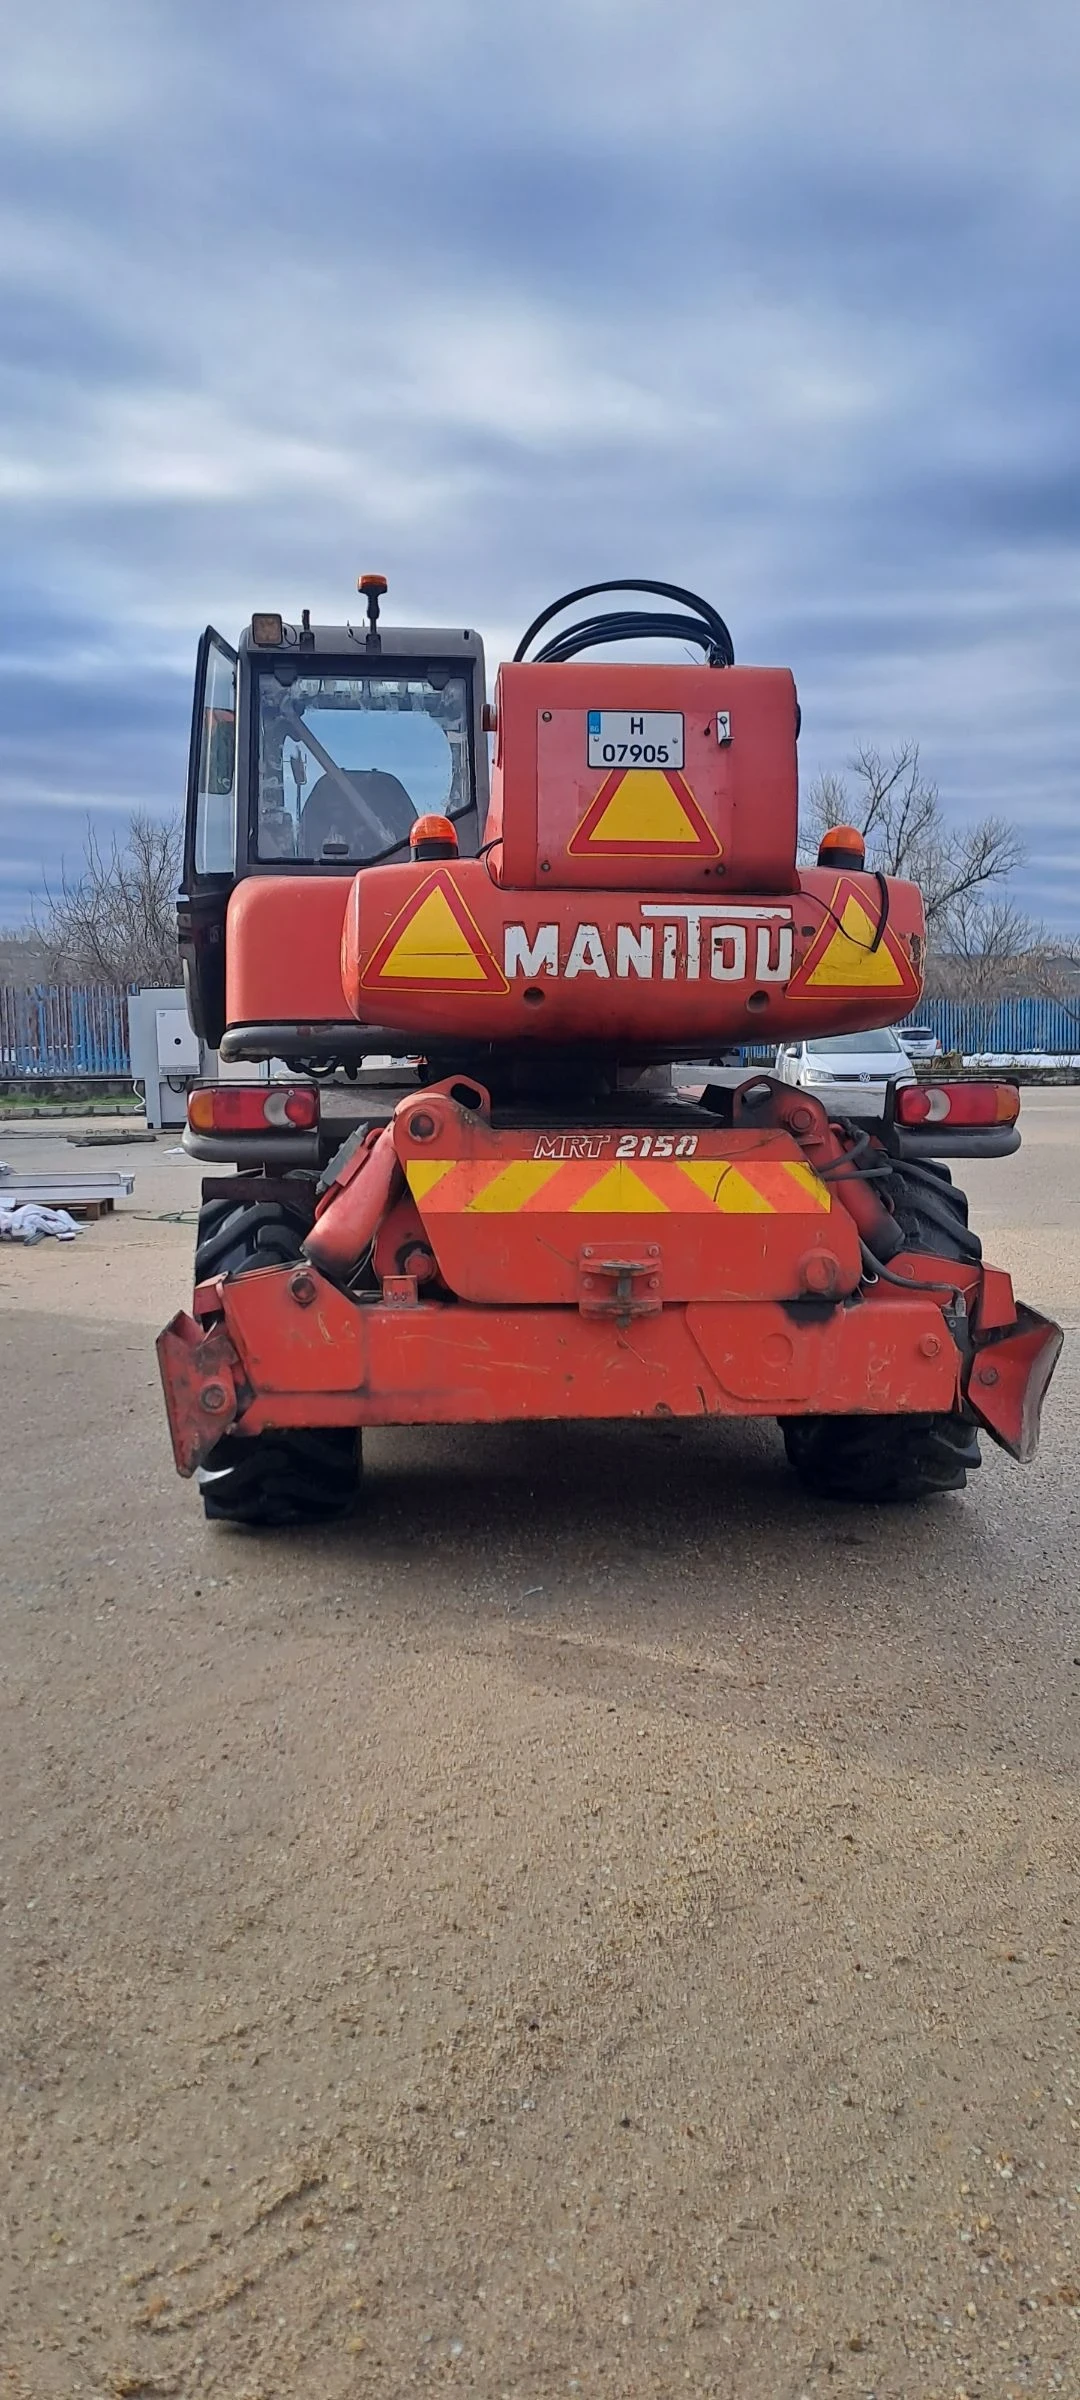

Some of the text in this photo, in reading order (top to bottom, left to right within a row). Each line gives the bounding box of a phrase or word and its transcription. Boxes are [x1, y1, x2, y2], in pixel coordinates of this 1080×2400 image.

[589, 725, 600, 733] BG
[630, 717, 643, 735] H
[602, 744, 669, 763] 07905
[504, 903, 793, 981] MANITOU
[533, 1135, 699, 1158] MRT 2150
